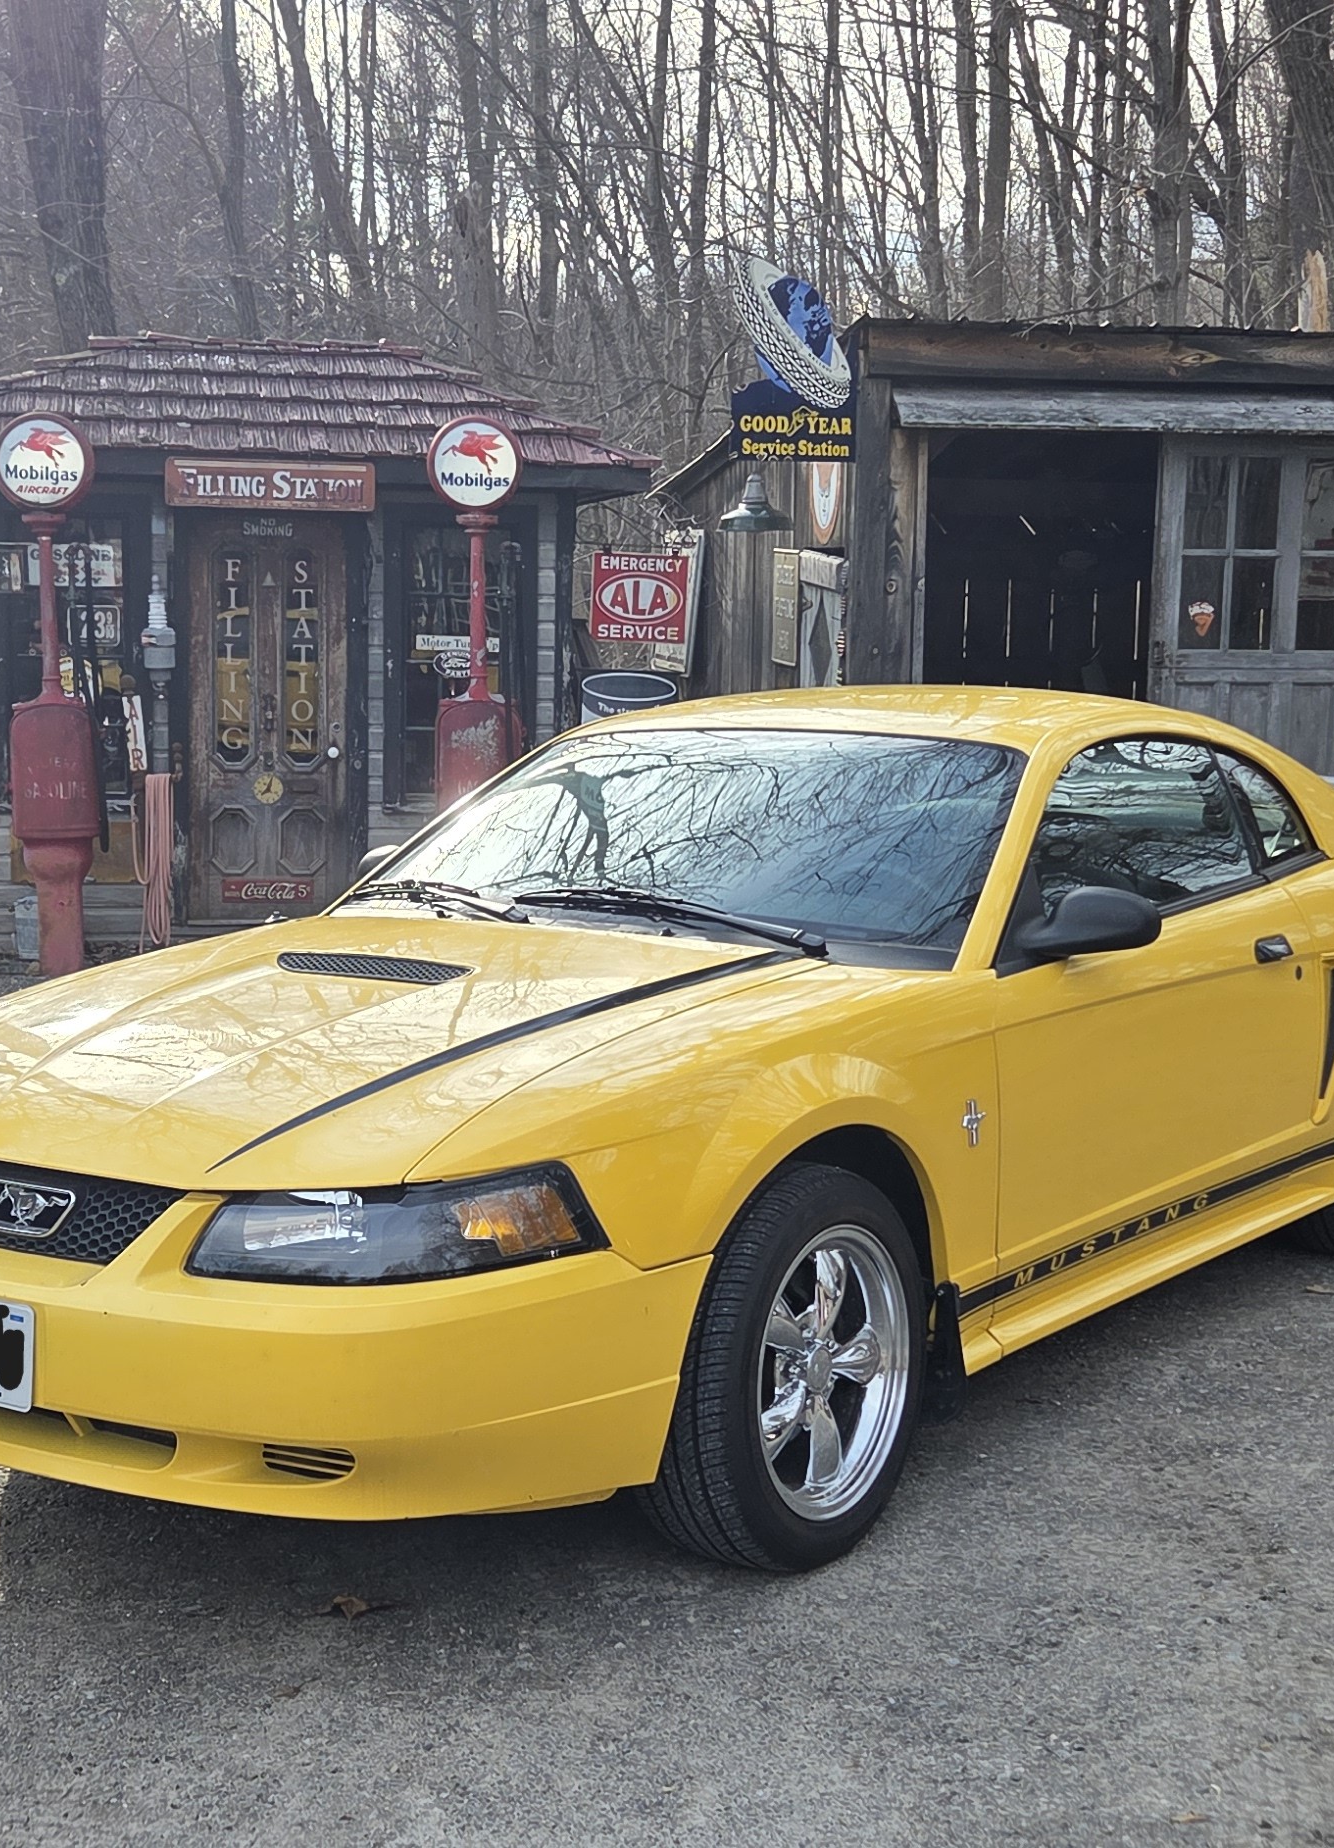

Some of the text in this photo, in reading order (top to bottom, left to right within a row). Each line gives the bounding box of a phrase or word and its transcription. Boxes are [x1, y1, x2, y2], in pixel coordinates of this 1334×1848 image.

[742, 438, 849, 456] Service Station
[5, 464, 78, 485] Mobilgas
[178, 468, 265, 498] FILLING
[441, 472, 510, 490] Mobilgas
[16, 485, 69, 495] AIRCRAFT
[243, 521, 293, 536] SMOKING
[261, 518, 276, 526] NO
[30, 549, 112, 563] GSLNE
[601, 556, 682, 573] EMERGENCY
[609, 580, 668, 616] ALA
[597, 624, 679, 641] SERVICE
[421, 638, 452, 649] Motor
[221, 559, 243, 750] FILLING
[291, 560, 313, 750] STATION
[129, 702, 144, 769] AIR
[24, 781, 88, 799] GAOLINE
[1014, 1193, 1208, 1288] MUSTANG
